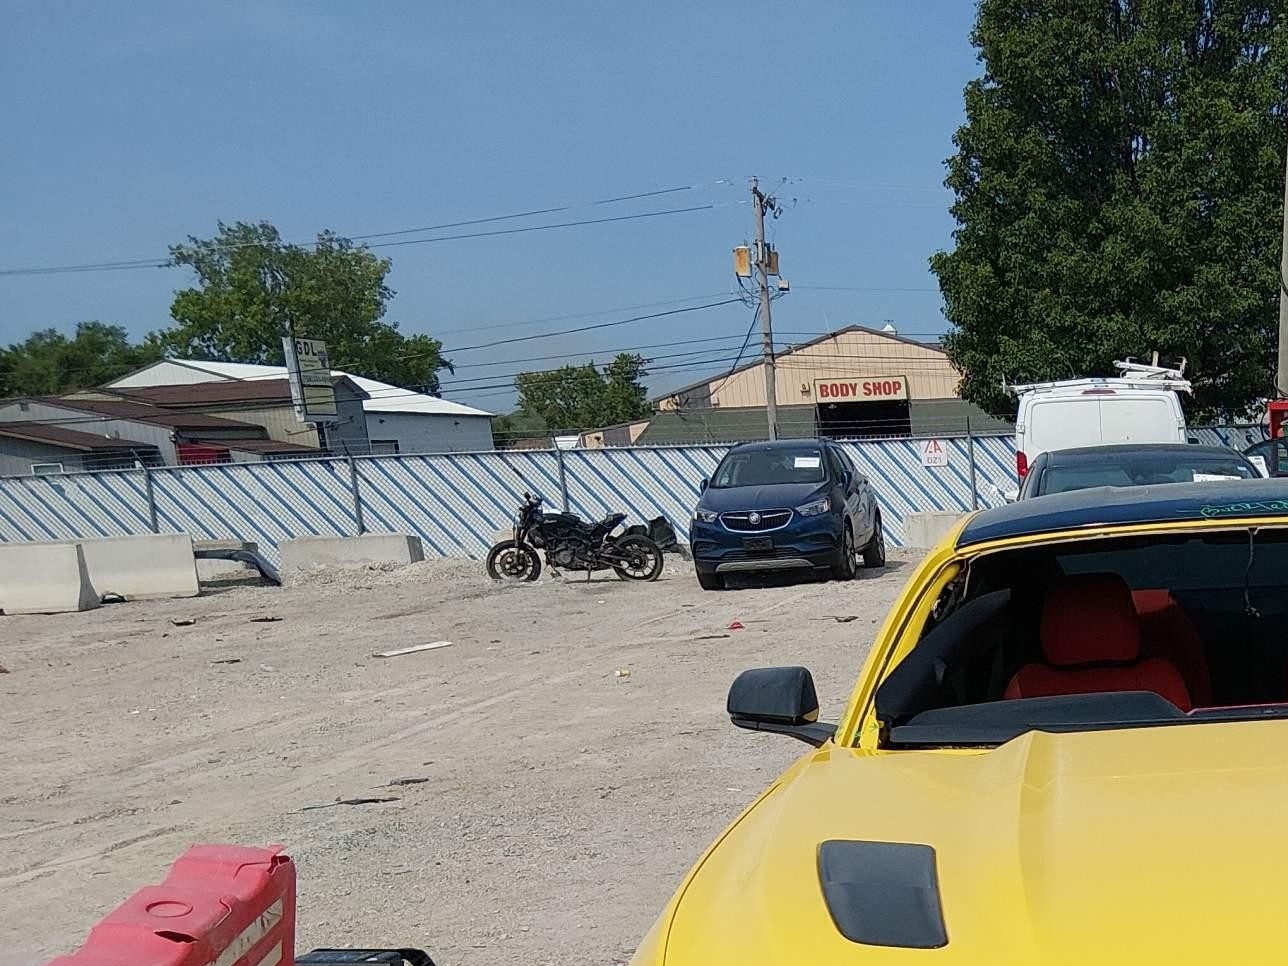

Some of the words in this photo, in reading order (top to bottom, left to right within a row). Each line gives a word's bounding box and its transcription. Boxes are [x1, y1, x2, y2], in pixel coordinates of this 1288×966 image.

[296, 341, 317, 356] GDL
[820, 383, 857, 397] BODY
[862, 381, 902, 396] SHOP
